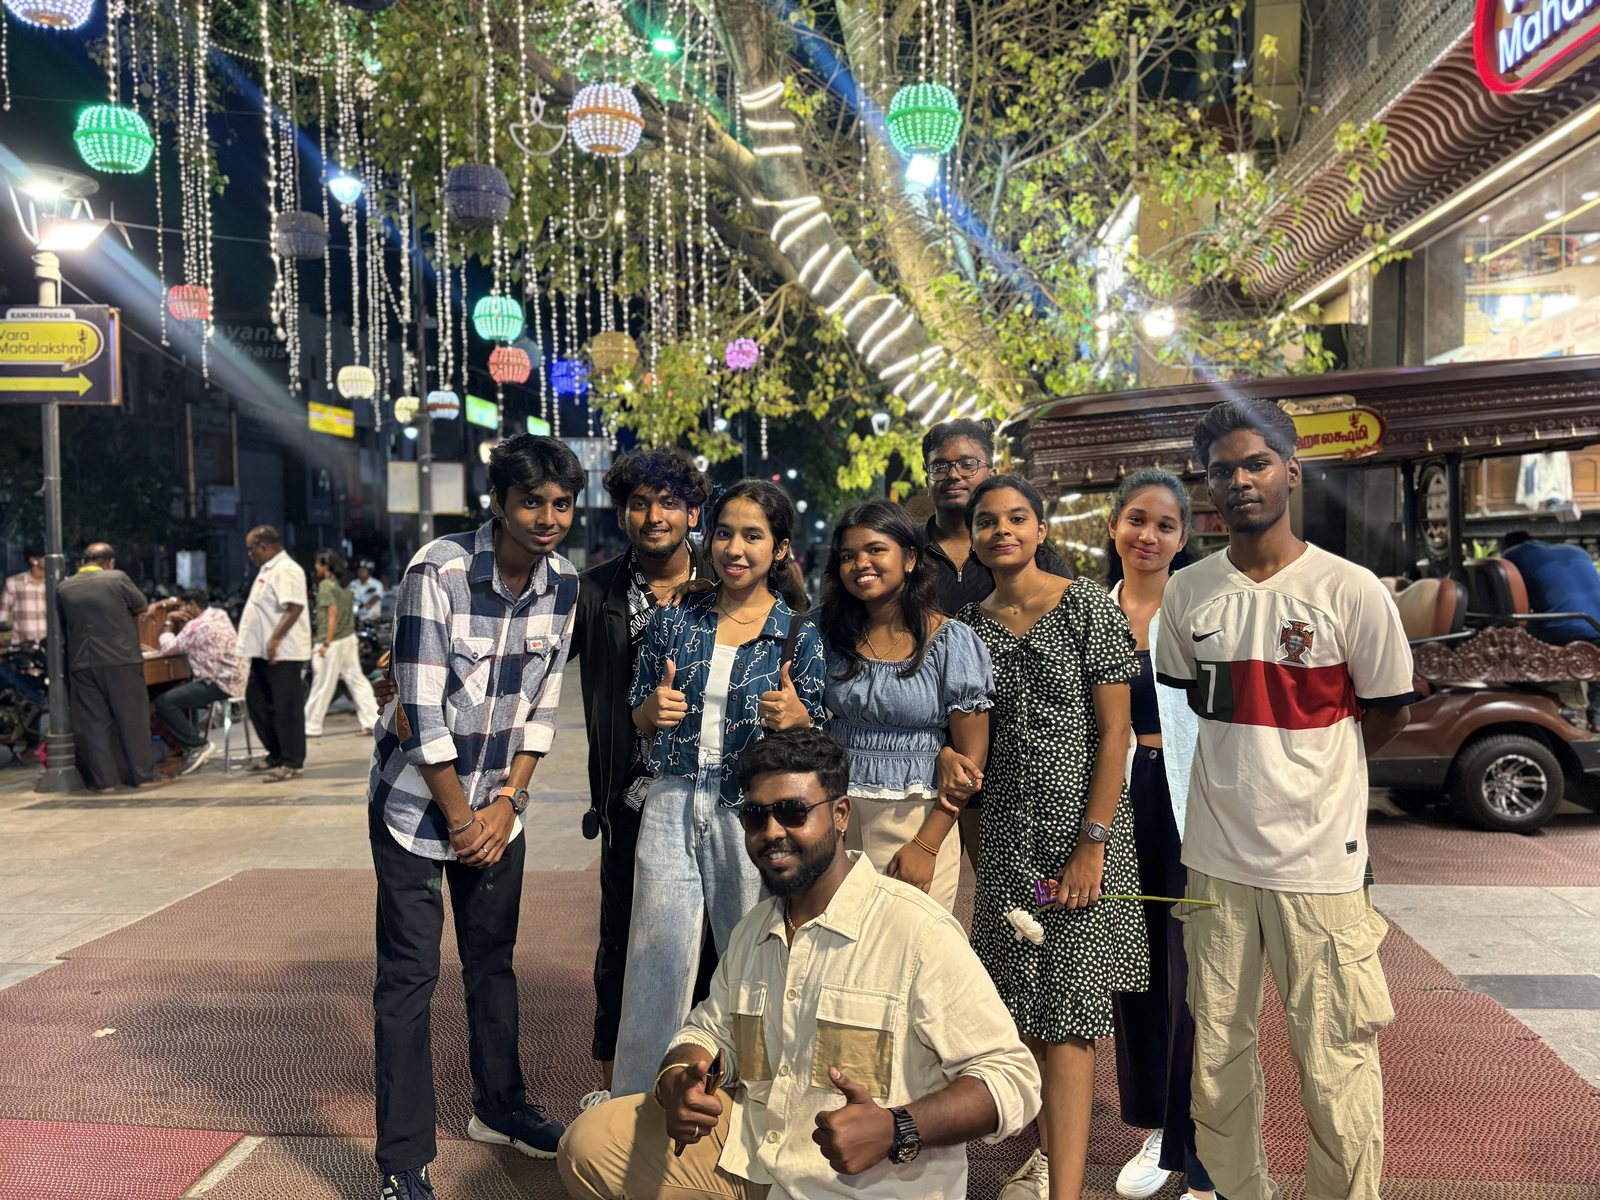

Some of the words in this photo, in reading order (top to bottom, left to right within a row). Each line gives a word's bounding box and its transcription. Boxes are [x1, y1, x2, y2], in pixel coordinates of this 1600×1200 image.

[1499, 0, 1594, 74] Maha
[0, 341, 86, 355] Mahalakshmi
[168, 319, 283, 342] Naayan
[1201, 664, 1217, 713] 7
